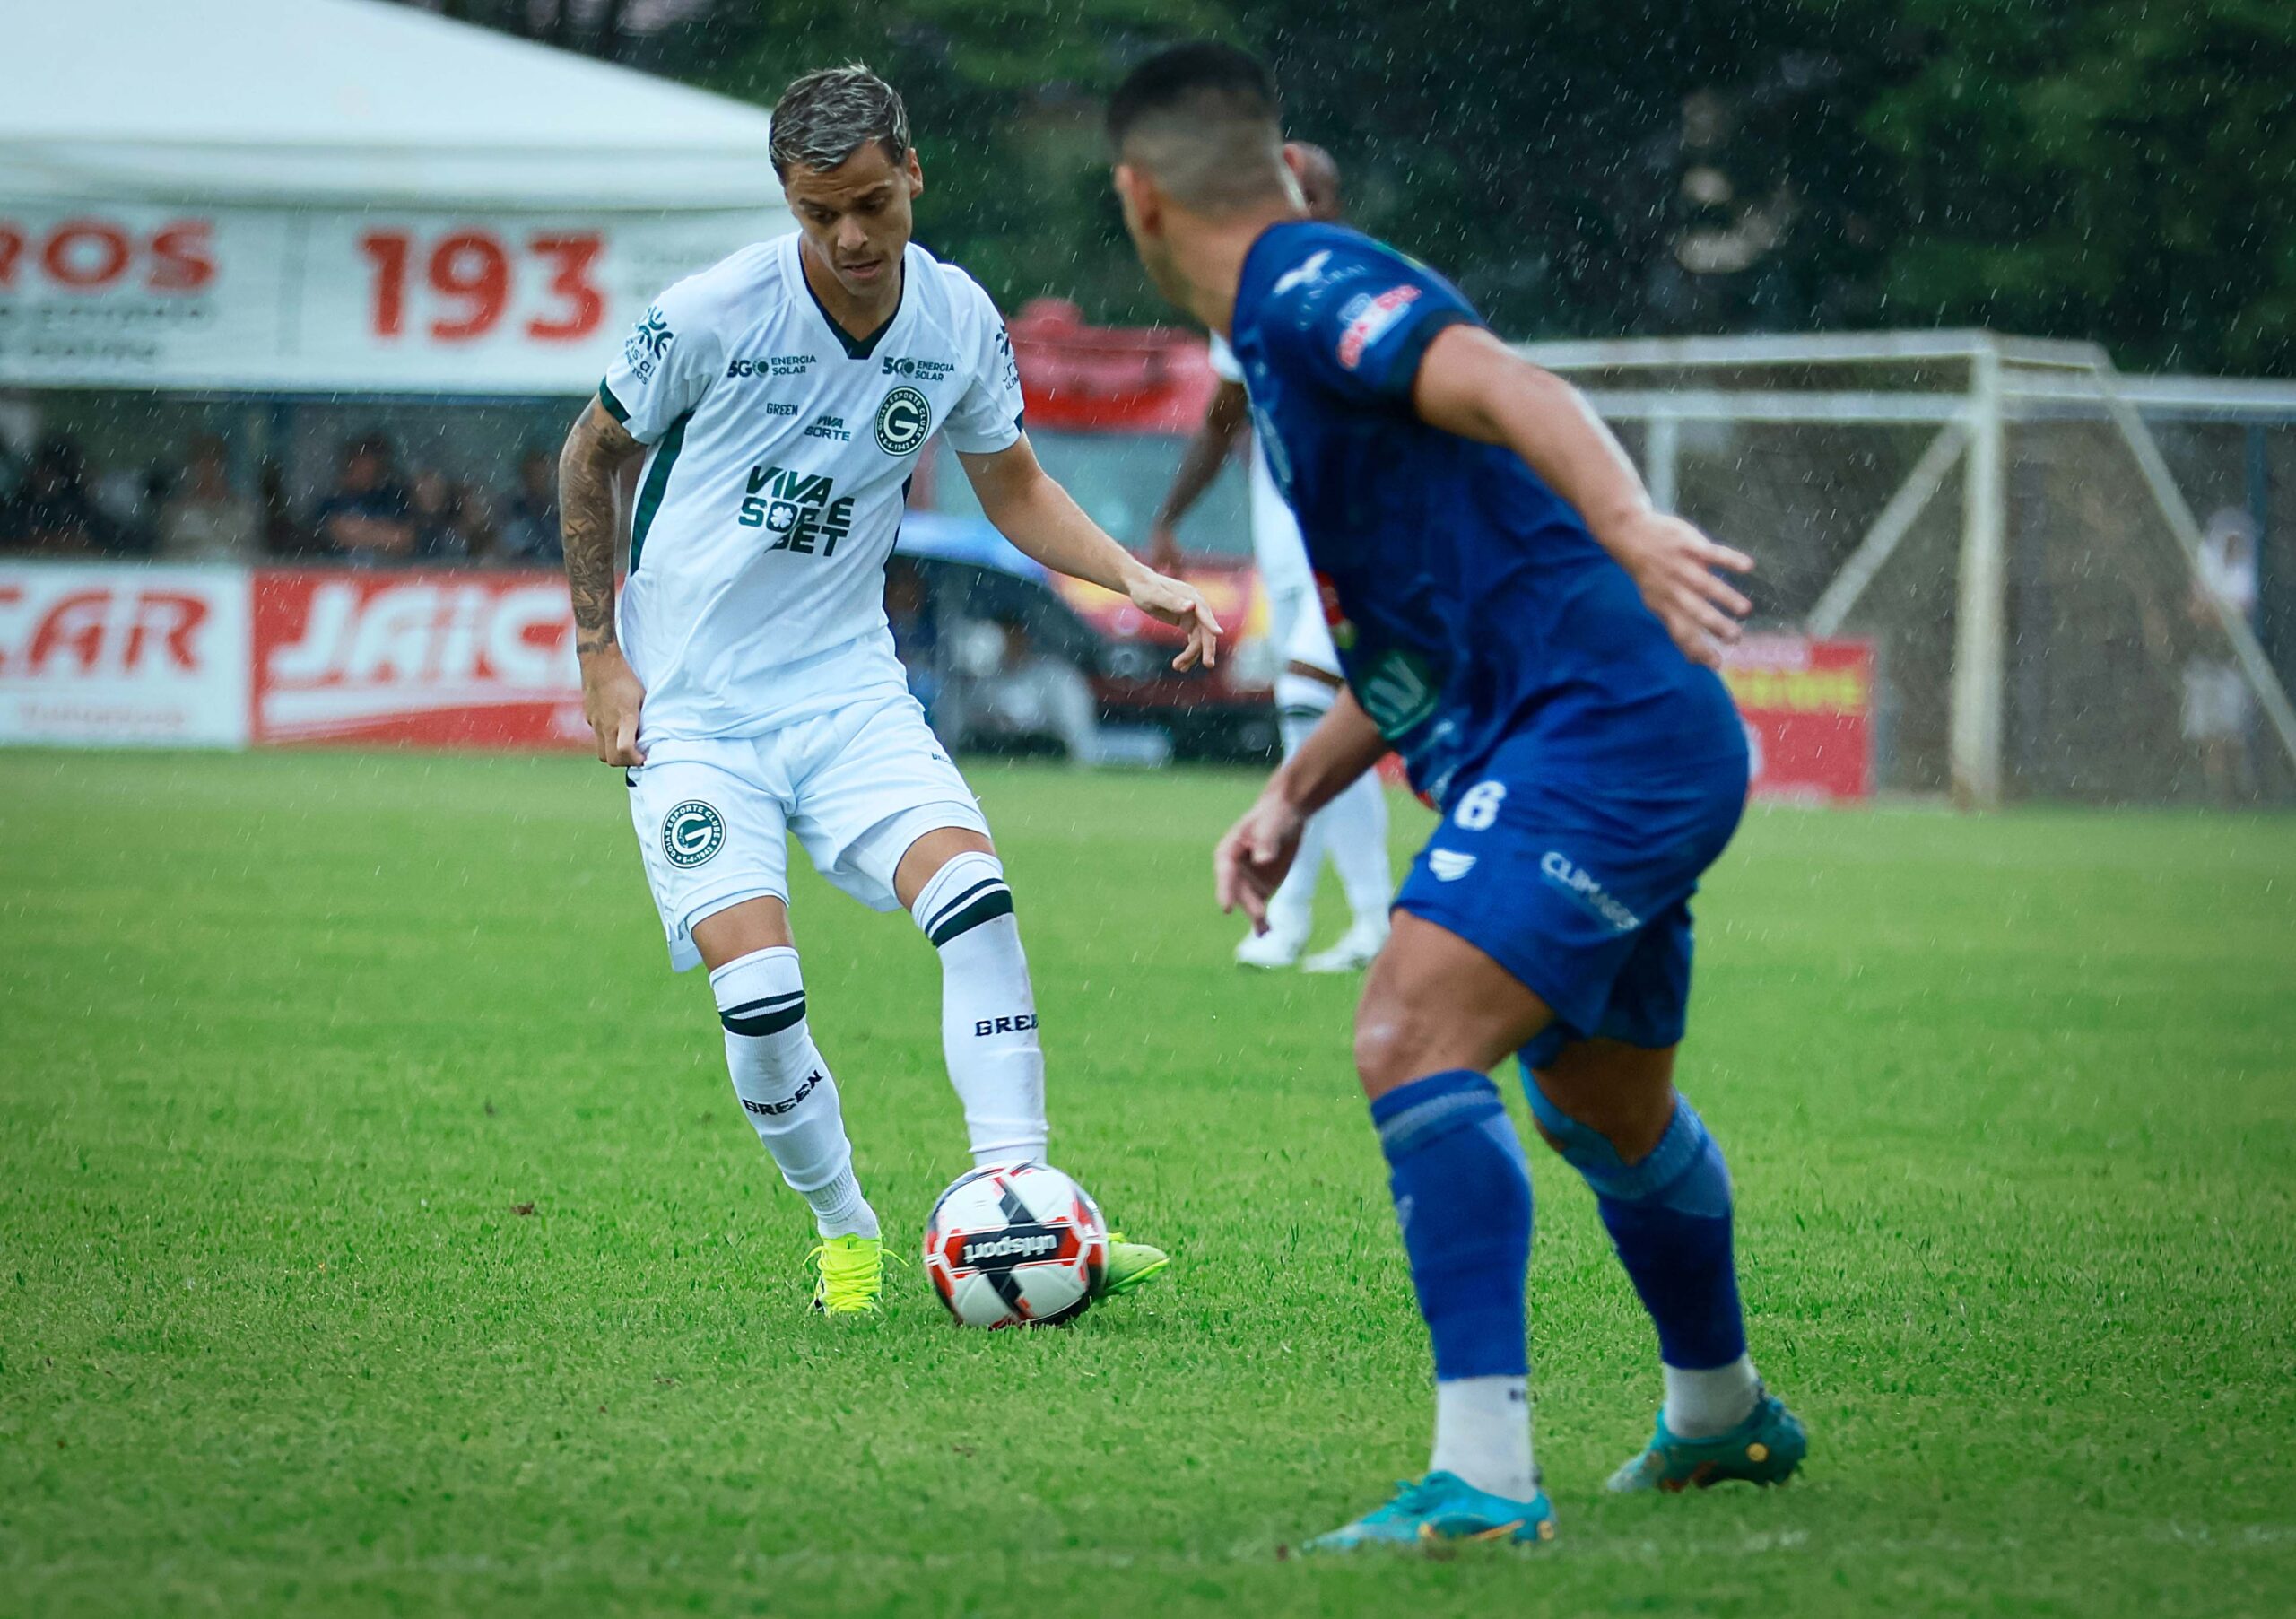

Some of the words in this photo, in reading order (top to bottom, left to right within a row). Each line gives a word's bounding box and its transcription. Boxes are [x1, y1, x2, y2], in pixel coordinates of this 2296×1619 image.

[358, 224, 605, 341] 193
[771, 354, 817, 366] ENERGIA
[772, 366, 806, 376] SOLAR
[917, 361, 955, 372] ENERGIA
[915, 370, 944, 381] SOLAR
[766, 403, 798, 416] GREEN
[889, 392, 923, 408] ESPORTE
[916, 407, 926, 438] CLUBE
[804, 426, 851, 441] SORTE
[746, 466, 834, 508] VIVA
[266, 581, 581, 687] JAIC
[1454, 780, 1507, 832] 6
[666, 805, 705, 828] ESPORTE
[705, 810, 721, 839] CLUBE
[974, 1014, 1039, 1037] GREE
[742, 1069, 823, 1115] GREEN
[962, 1234, 1058, 1264] uhlsport
